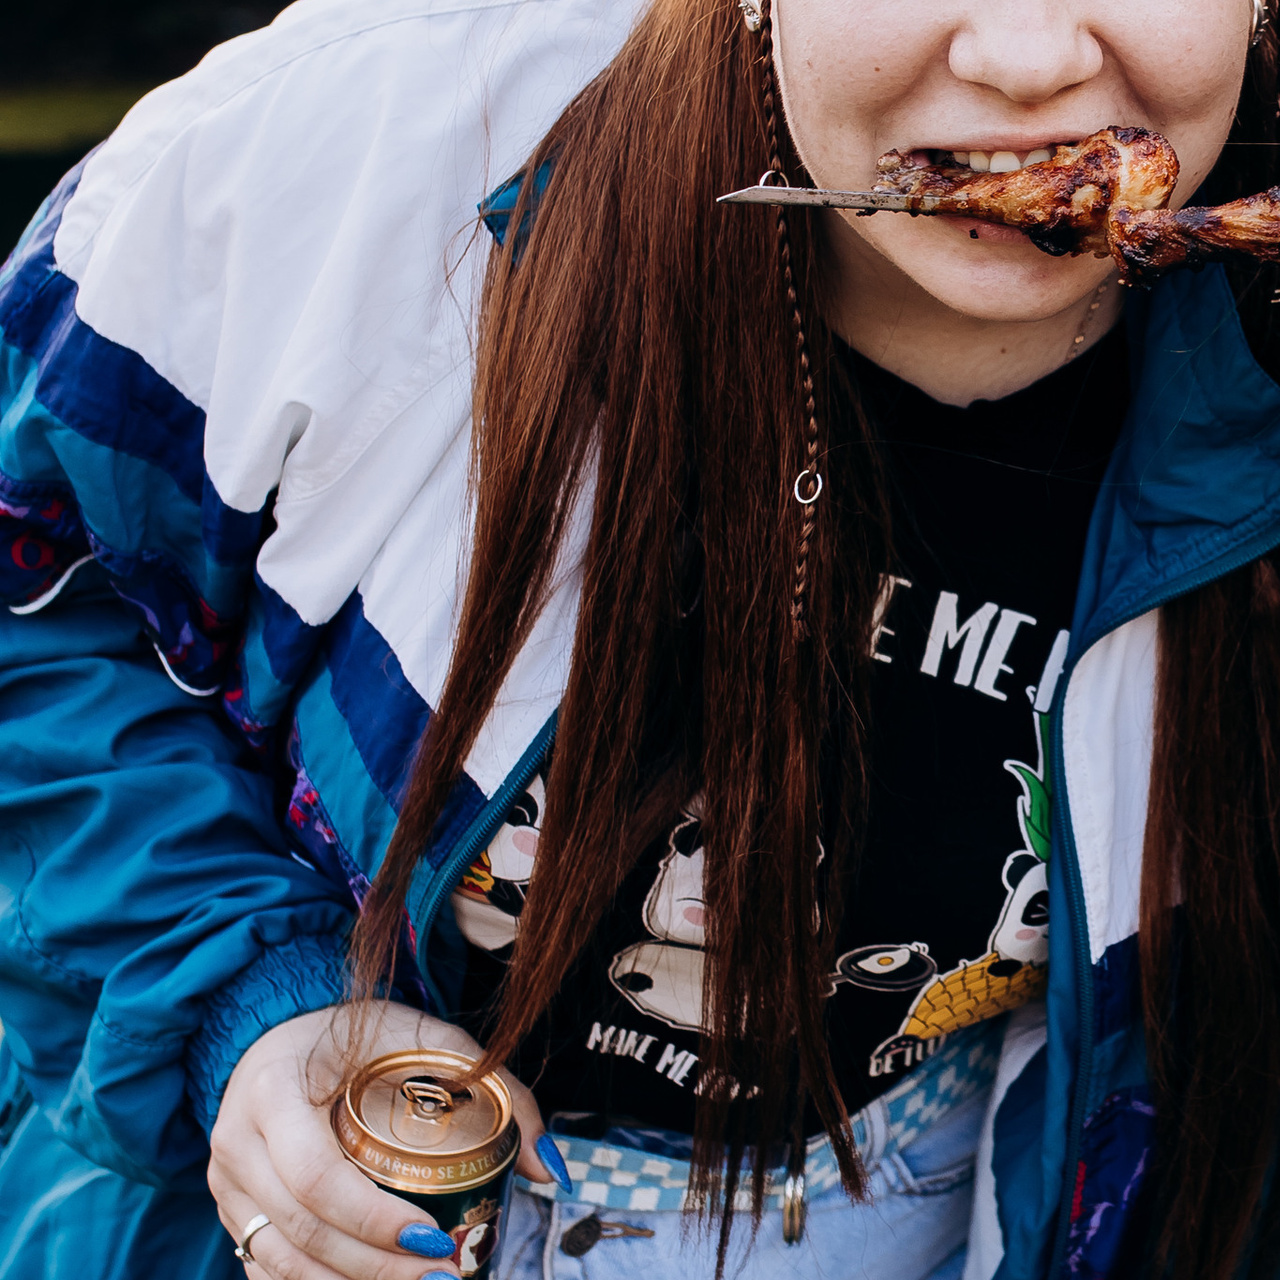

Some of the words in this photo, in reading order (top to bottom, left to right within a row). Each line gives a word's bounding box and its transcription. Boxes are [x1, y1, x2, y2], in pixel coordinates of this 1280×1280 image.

[919, 589, 1037, 702] ME
[586, 1021, 659, 1063] MAKE
[655, 1043, 701, 1088] ME
[364, 1146, 433, 1180] UVAŘENO
[437, 1165, 455, 1180] SE
